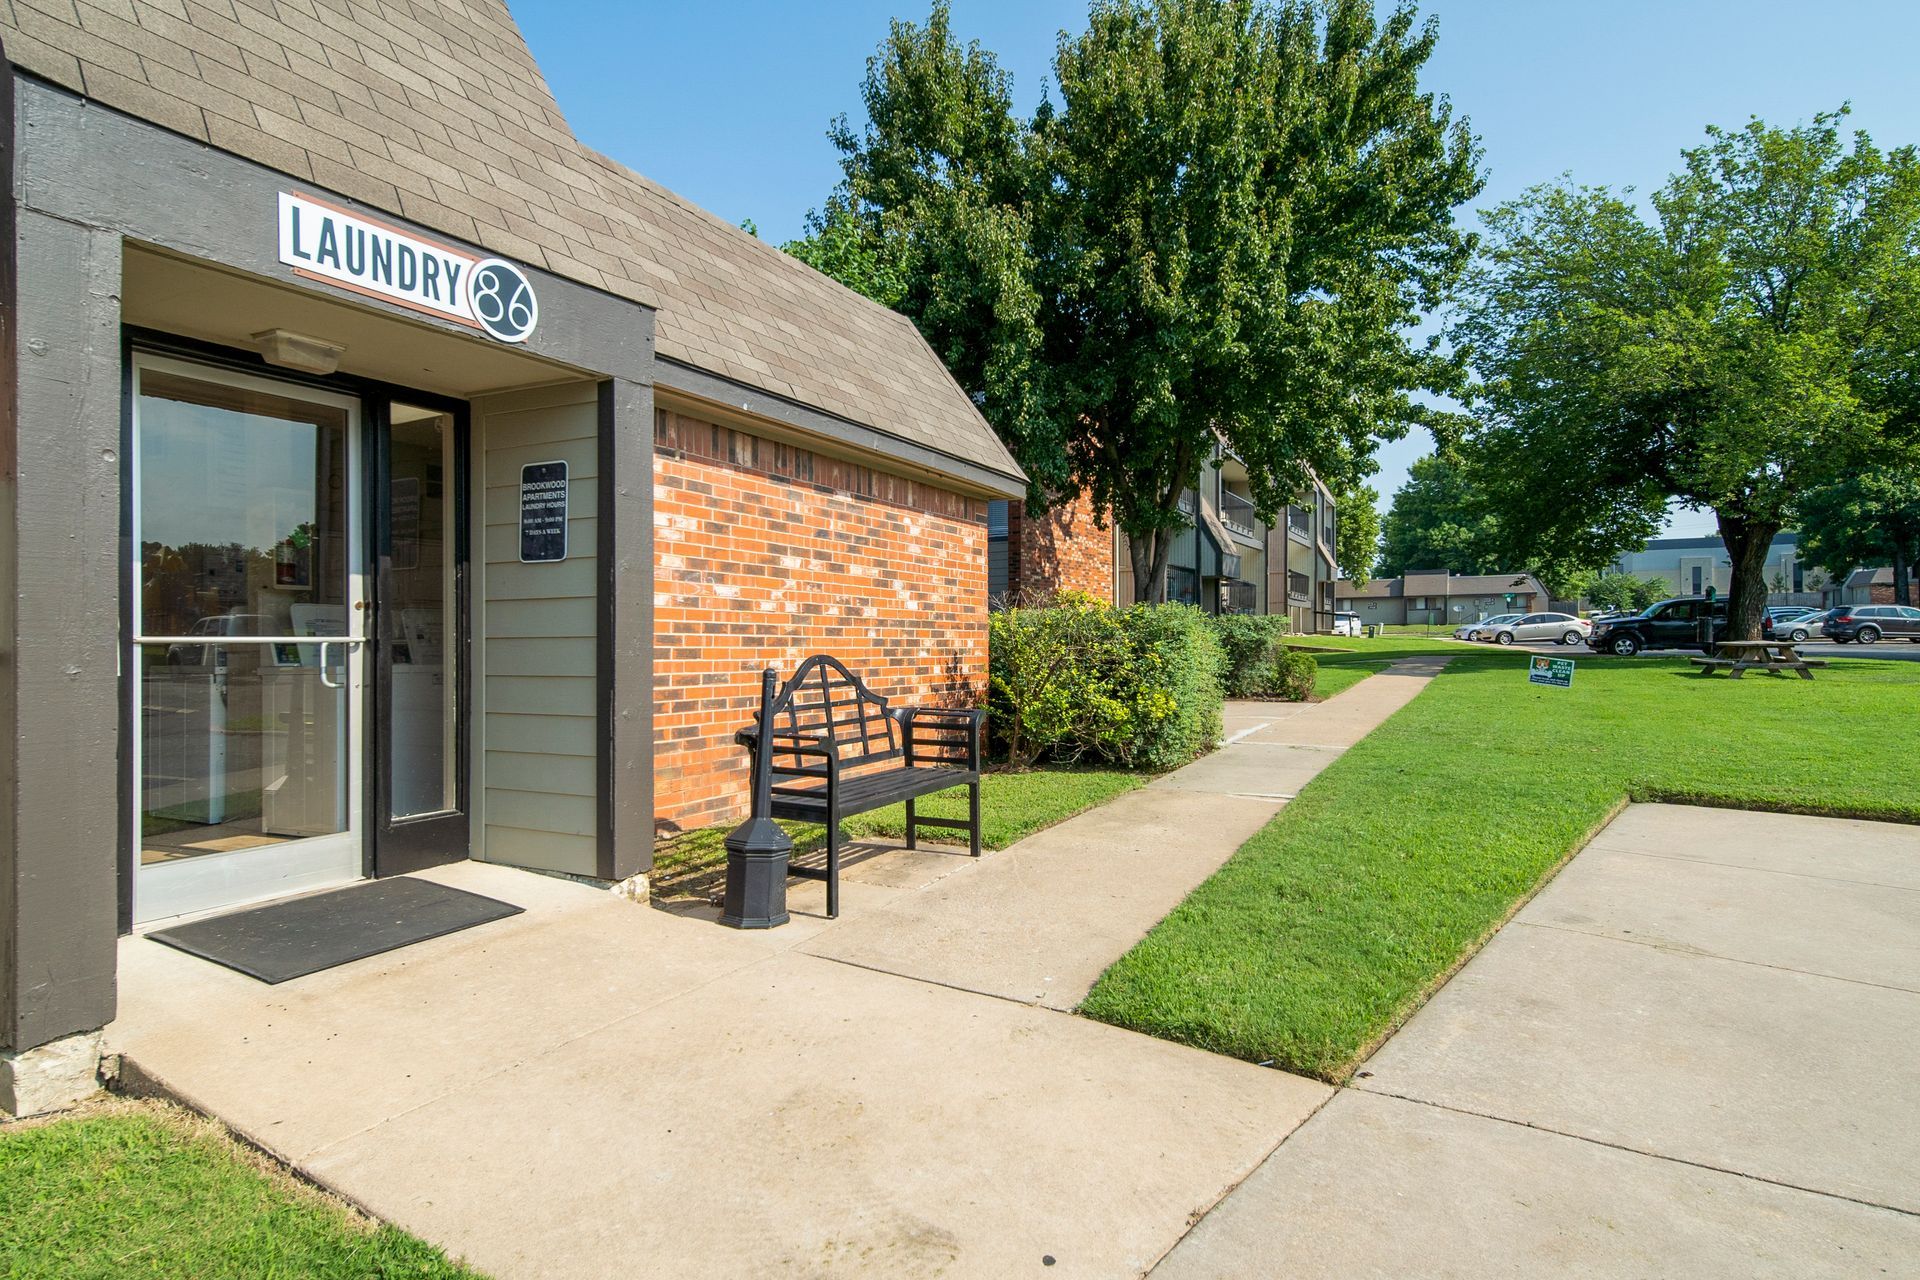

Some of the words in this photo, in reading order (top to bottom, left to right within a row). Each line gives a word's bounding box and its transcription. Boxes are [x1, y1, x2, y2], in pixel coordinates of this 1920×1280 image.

[291, 205, 461, 307] LAUNDRY
[474, 270, 532, 332] 86
[522, 480, 566, 491] BROOKWOOD
[522, 491, 565, 501] APARTMENTS
